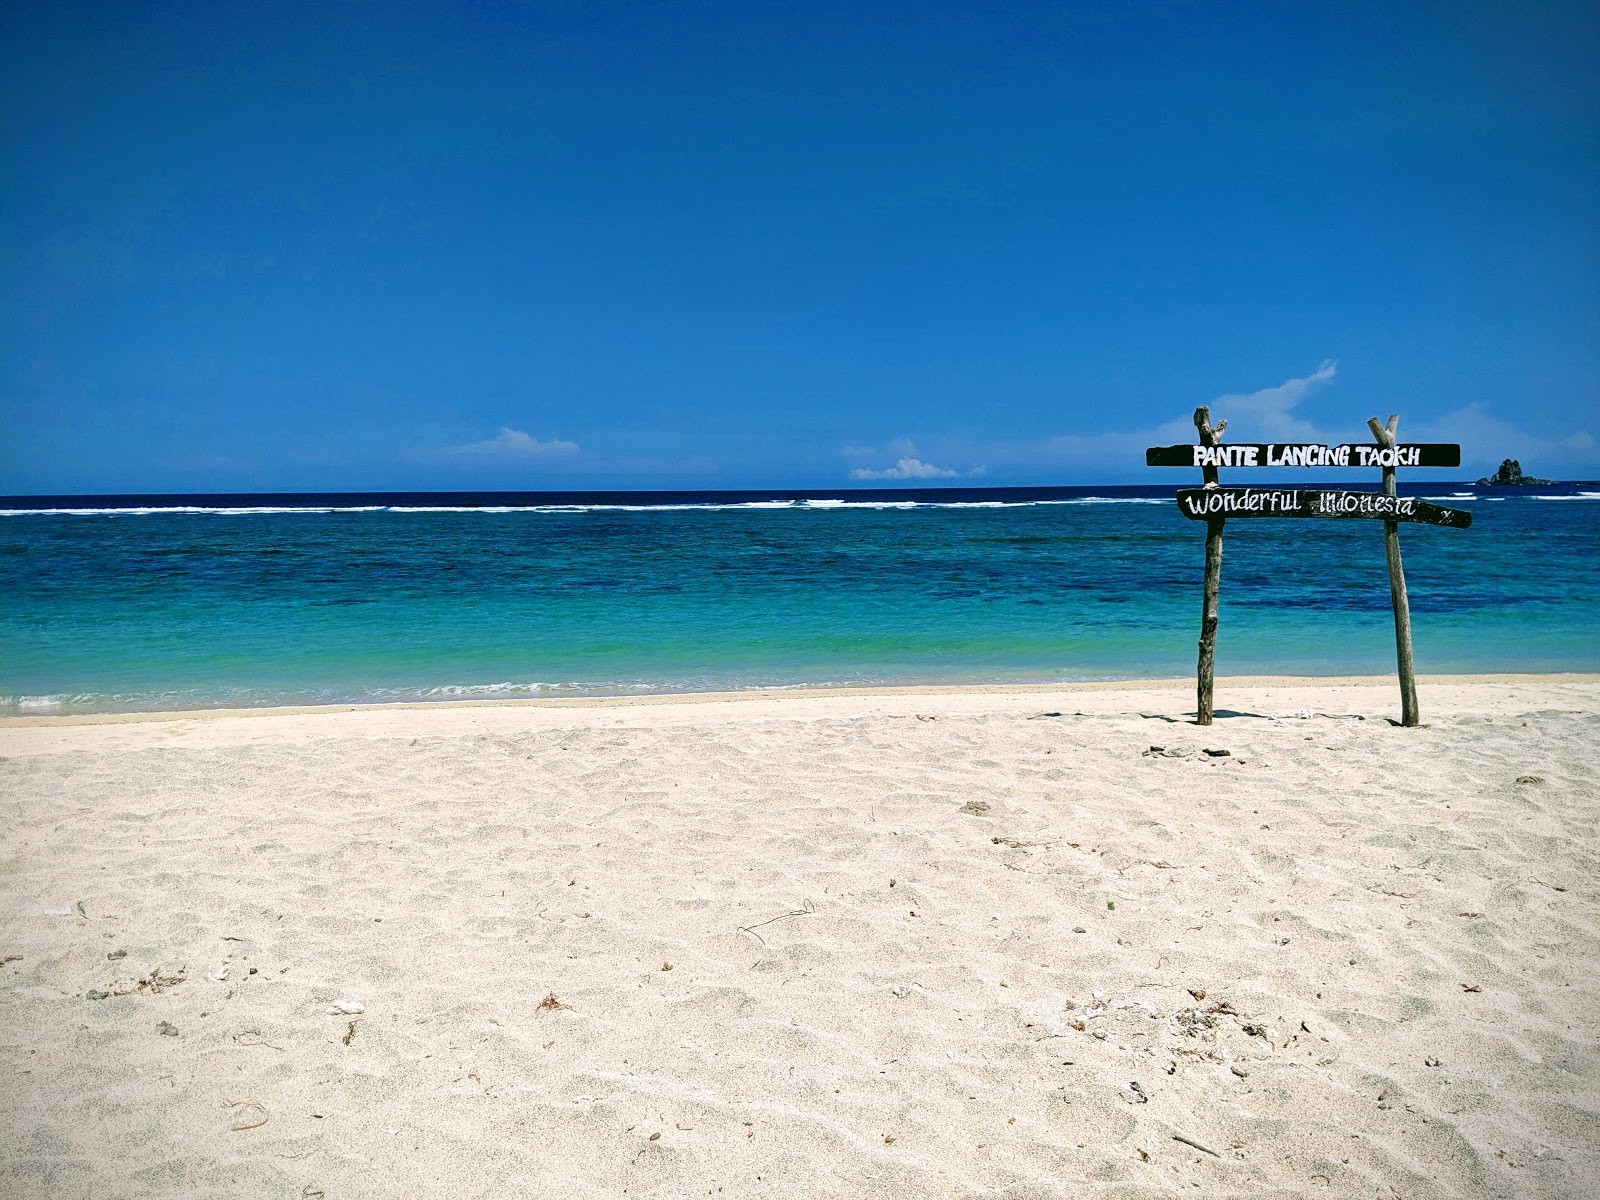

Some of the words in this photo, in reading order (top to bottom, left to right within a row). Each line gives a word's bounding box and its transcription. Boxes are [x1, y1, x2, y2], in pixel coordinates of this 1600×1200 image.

[1193, 445, 1259, 466] PANTE
[1266, 445, 1350, 466] LANCING
[1355, 445, 1421, 467] TAOKH
[1185, 489, 1301, 514] Wonderful
[1319, 491, 1416, 515] Indonesia
